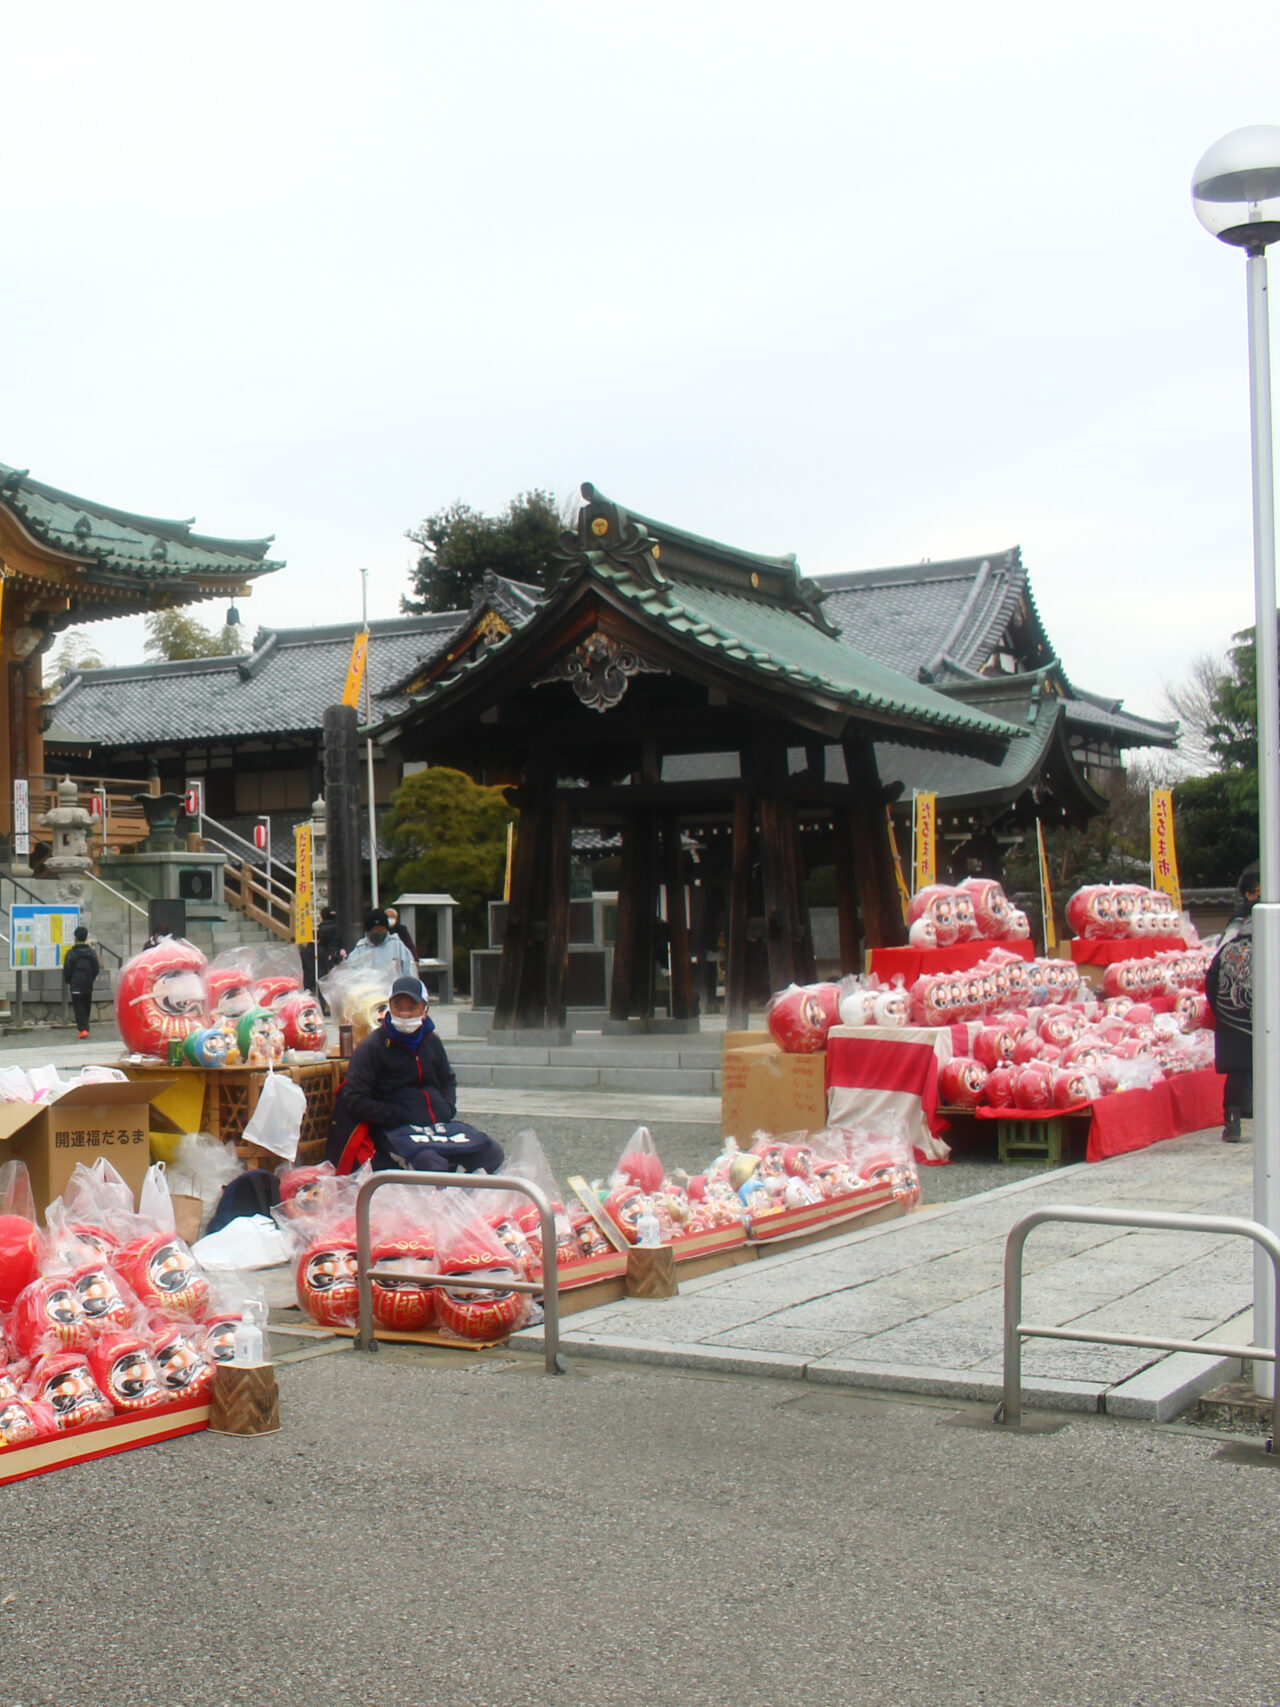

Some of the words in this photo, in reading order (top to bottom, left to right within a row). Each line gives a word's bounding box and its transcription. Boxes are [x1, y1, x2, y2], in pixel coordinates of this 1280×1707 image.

[55, 1128, 145, 1149] 開運福だるま
